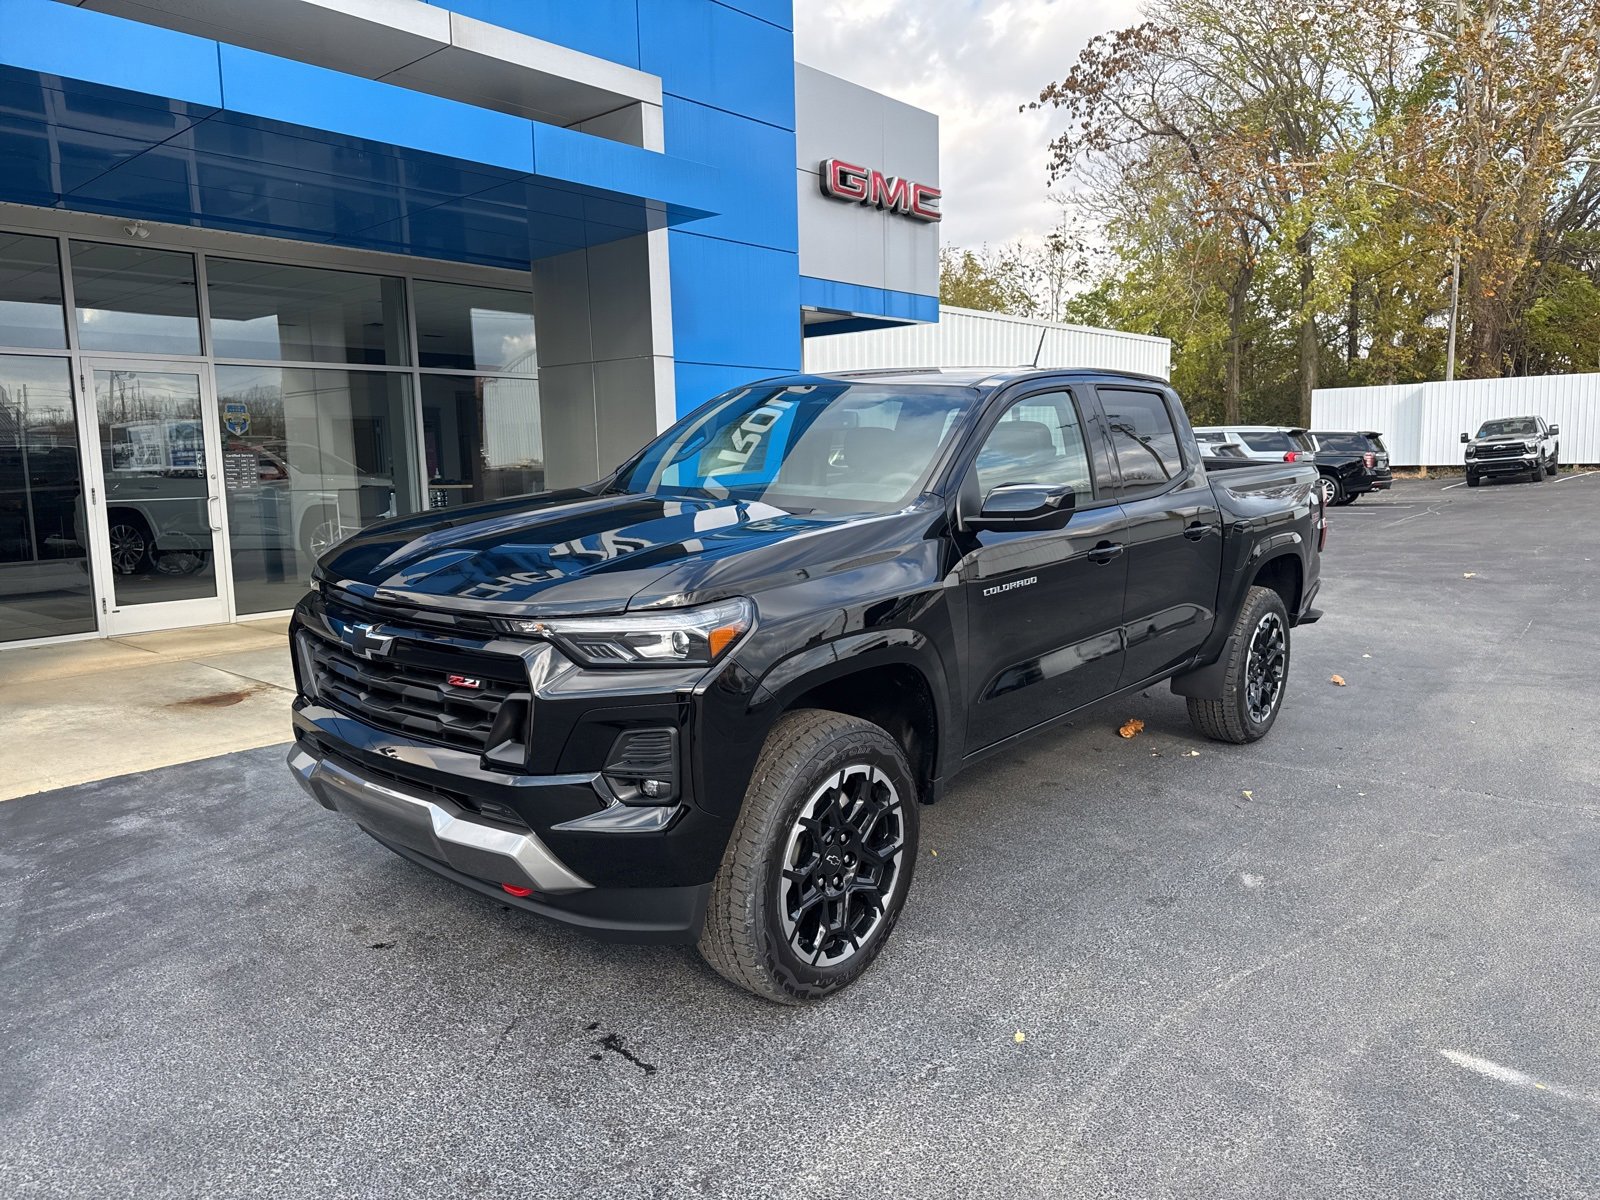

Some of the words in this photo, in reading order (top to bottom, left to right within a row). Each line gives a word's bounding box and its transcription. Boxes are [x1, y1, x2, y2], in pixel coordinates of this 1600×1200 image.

[820, 158, 942, 222] GMC
[983, 576, 1038, 597] COLORADO
[448, 675, 481, 689] Z71
